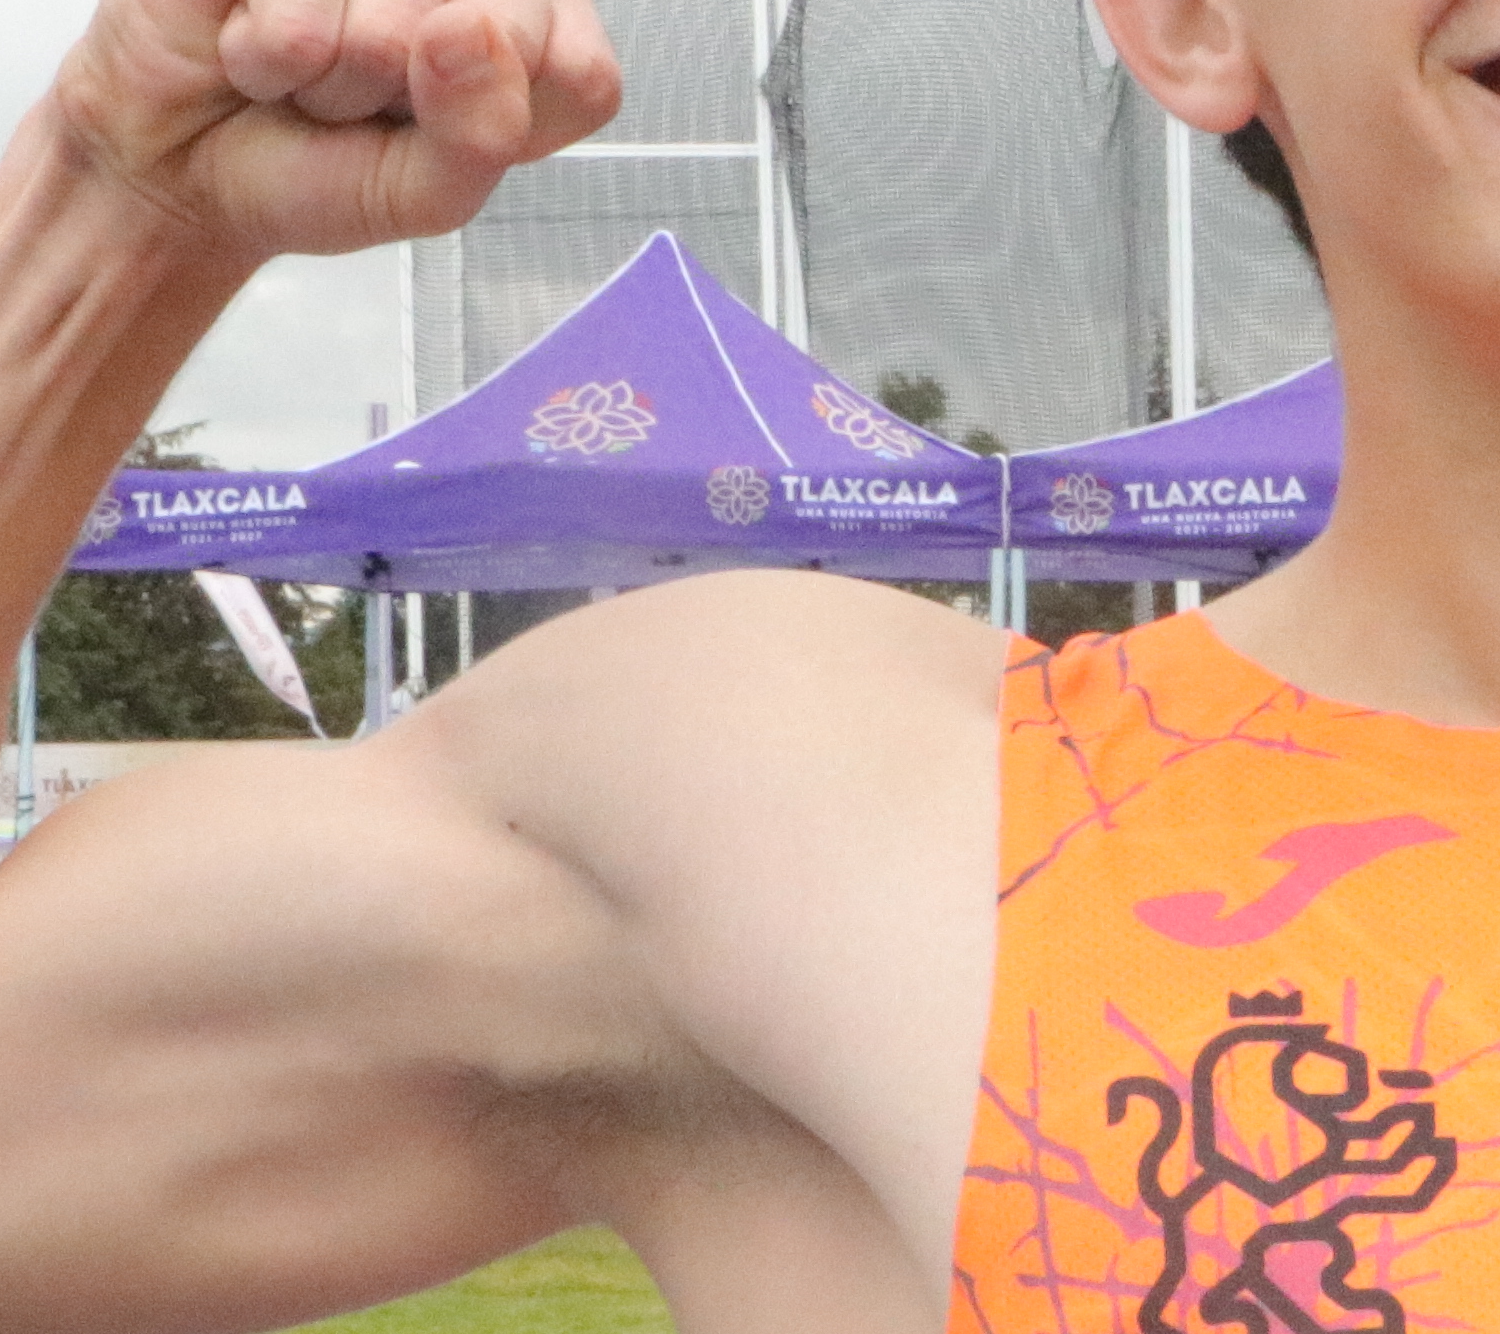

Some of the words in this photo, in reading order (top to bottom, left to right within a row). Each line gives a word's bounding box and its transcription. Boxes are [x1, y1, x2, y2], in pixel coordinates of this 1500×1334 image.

[131, 483, 307, 519] TLAXCALA
[780, 475, 958, 505] TLAXCALA
[1123, 475, 1306, 510] TLAXCALA
[147, 522, 176, 534] UNA
[180, 520, 227, 532] NUEVA
[230, 516, 298, 530] HISTORIA
[795, 507, 824, 518] UNA
[828, 508, 874, 519] NUEVA
[879, 509, 948, 521] HISTORIA
[1141, 513, 1170, 525] UNA
[1175, 512, 1221, 524] NUEVA
[1226, 508, 1297, 522] HISTORIA
